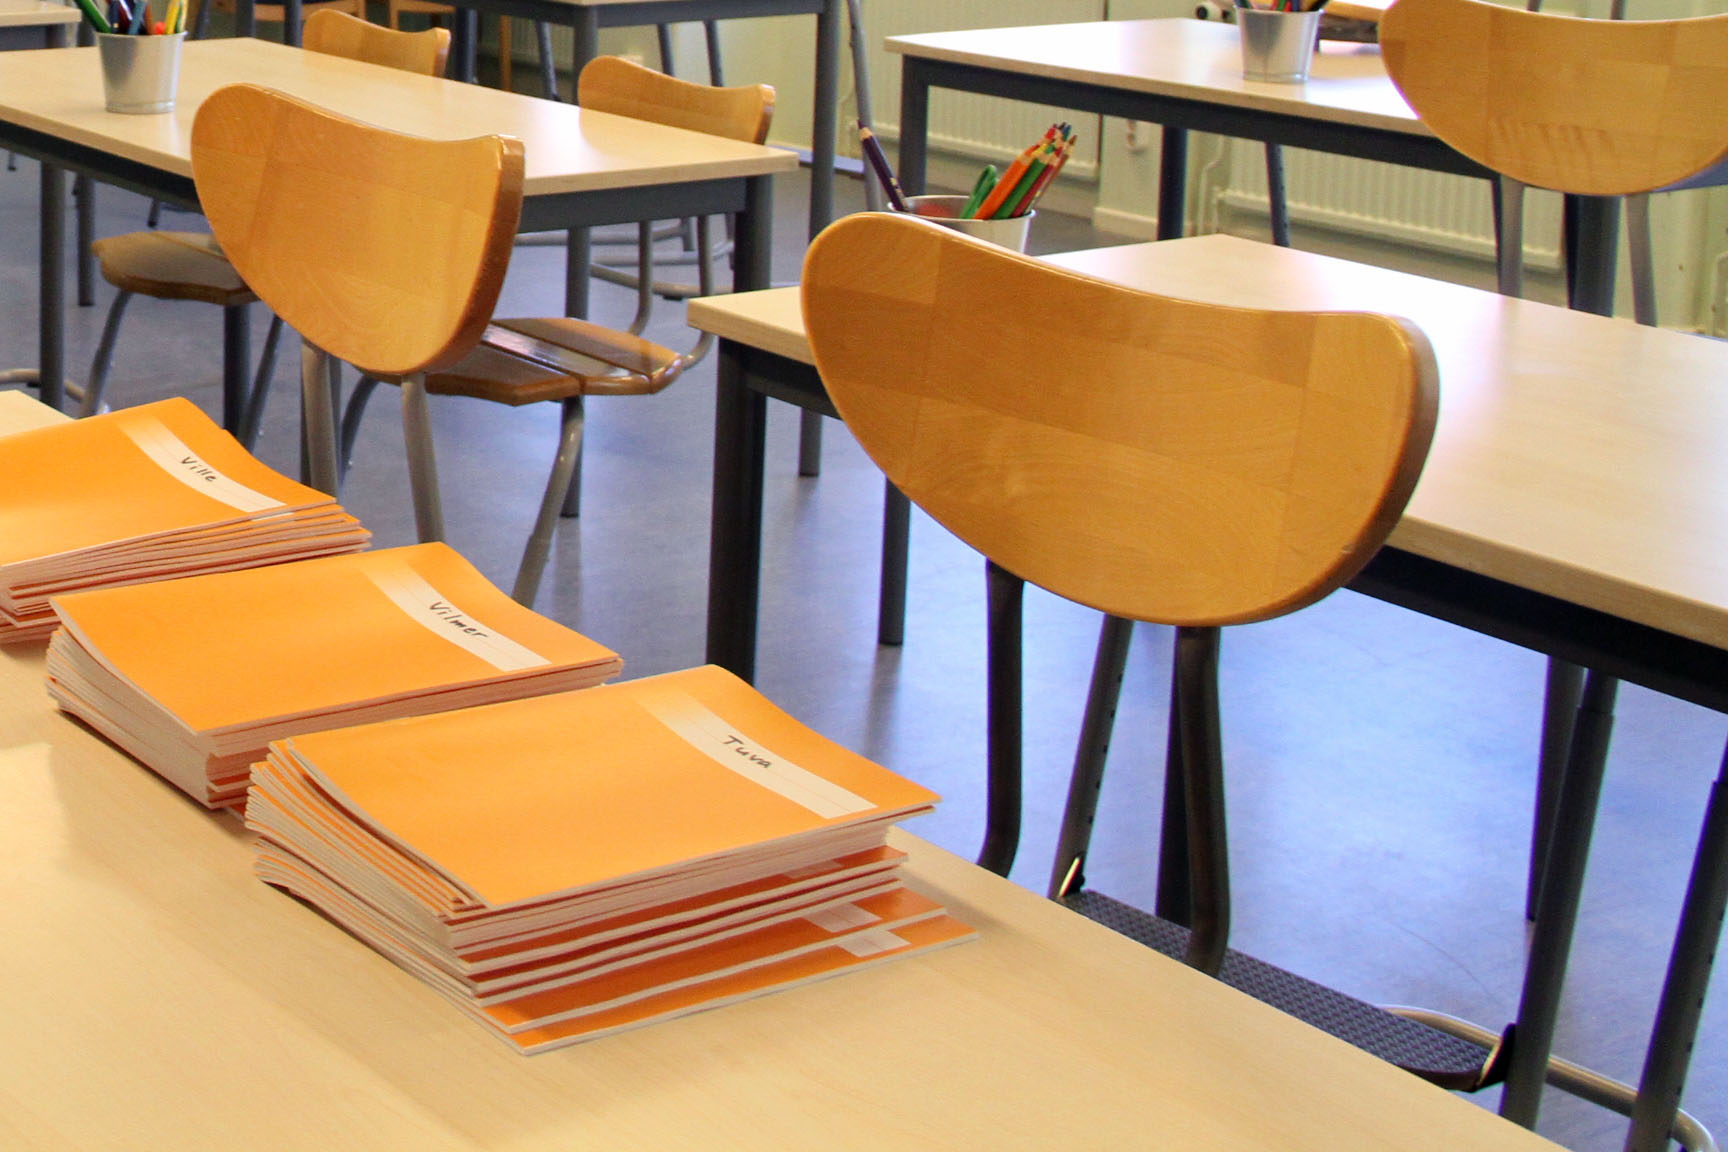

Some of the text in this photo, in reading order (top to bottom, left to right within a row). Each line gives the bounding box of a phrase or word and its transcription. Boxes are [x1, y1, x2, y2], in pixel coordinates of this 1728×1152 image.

[181, 456, 217, 482] Ville
[429, 601, 489, 638] Vilmer
[722, 734, 772, 769] Tuva
